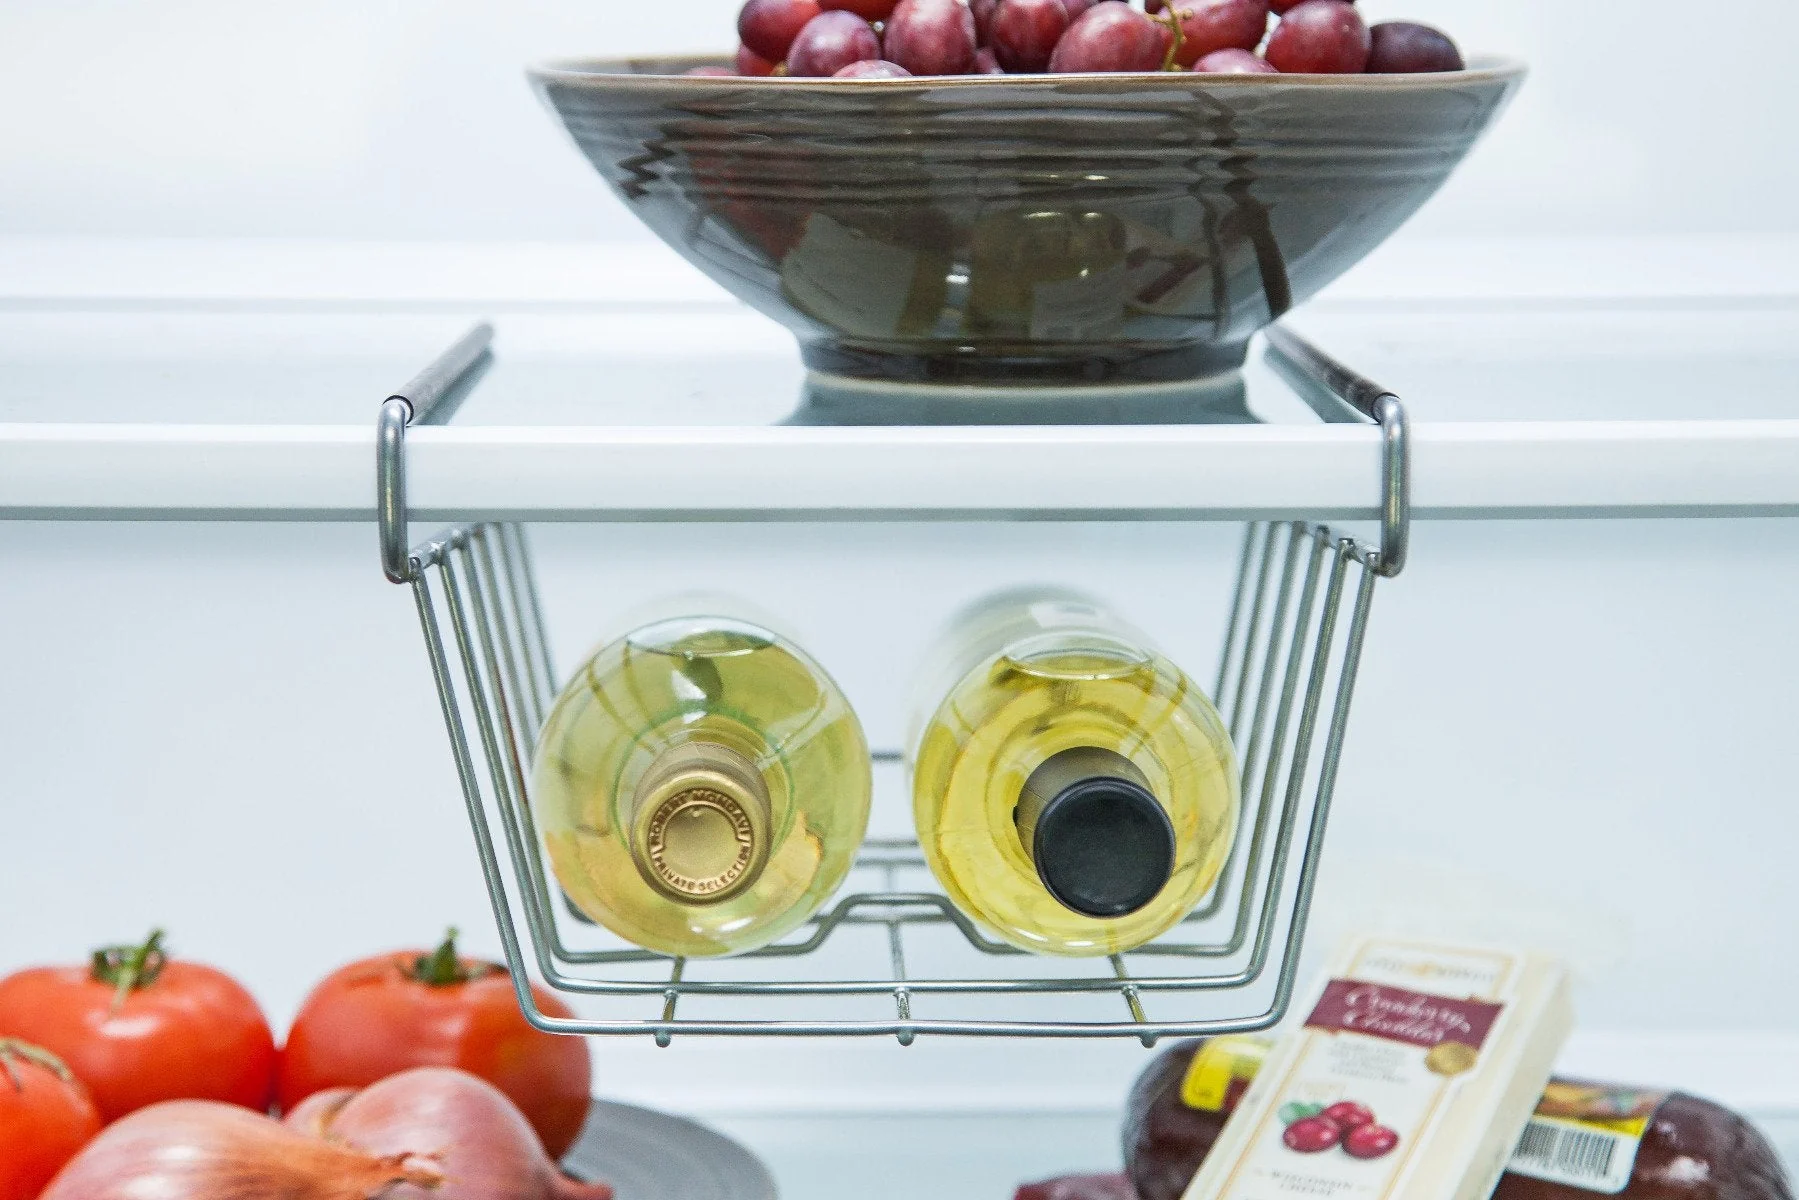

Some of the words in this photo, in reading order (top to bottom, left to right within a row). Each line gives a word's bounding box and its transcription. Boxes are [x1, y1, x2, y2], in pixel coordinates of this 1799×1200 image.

[649, 791, 689, 846] ROBERT
[691, 788, 752, 836] MONDAVI
[653, 856, 697, 892] PRIVATE
[698, 845, 750, 892] SELECTION
